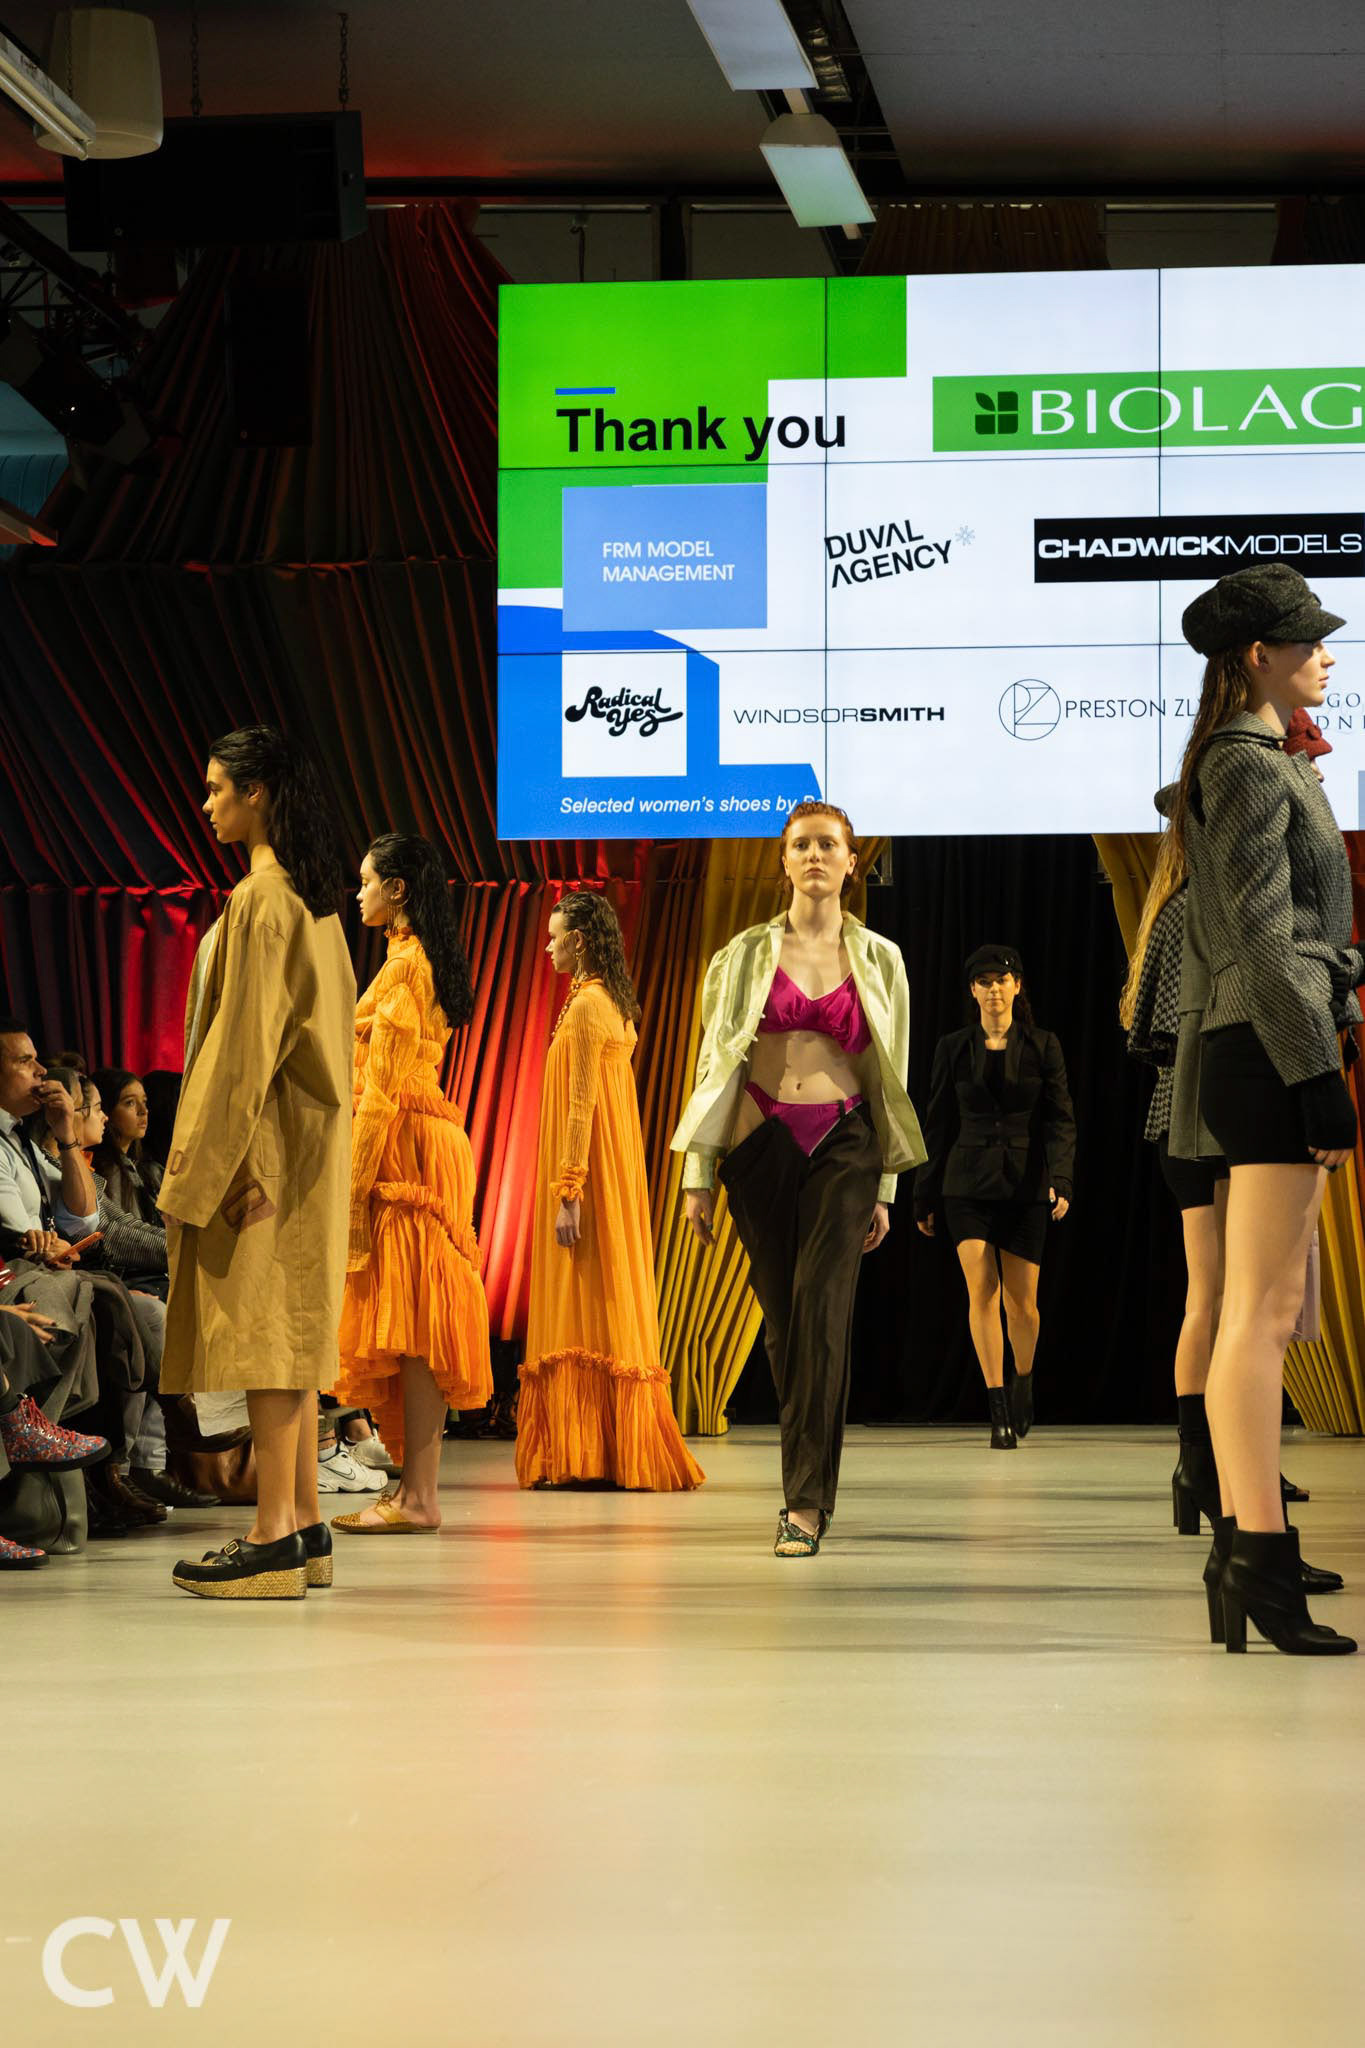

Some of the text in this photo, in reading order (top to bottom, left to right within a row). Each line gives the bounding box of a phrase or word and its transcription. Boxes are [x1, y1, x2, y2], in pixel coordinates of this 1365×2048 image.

[1031, 382, 1363, 436] BIOLAG
[555, 405, 846, 462] Thank you
[602, 540, 714, 559] FRM MODEL
[824, 519, 924, 560] DUVAL
[1038, 533, 1363, 559] CHADWICKMODELS
[602, 563, 735, 583] MANAGEMENT
[831, 539, 952, 589] AGENCY
[564, 686, 672, 722] Radical
[733, 706, 945, 724] WINDSORSMITH
[1065, 698, 1200, 718] PRESTON ZL
[559, 797, 635, 814] Selected
[719, 795, 771, 812] shoes
[775, 794, 798, 815] by
